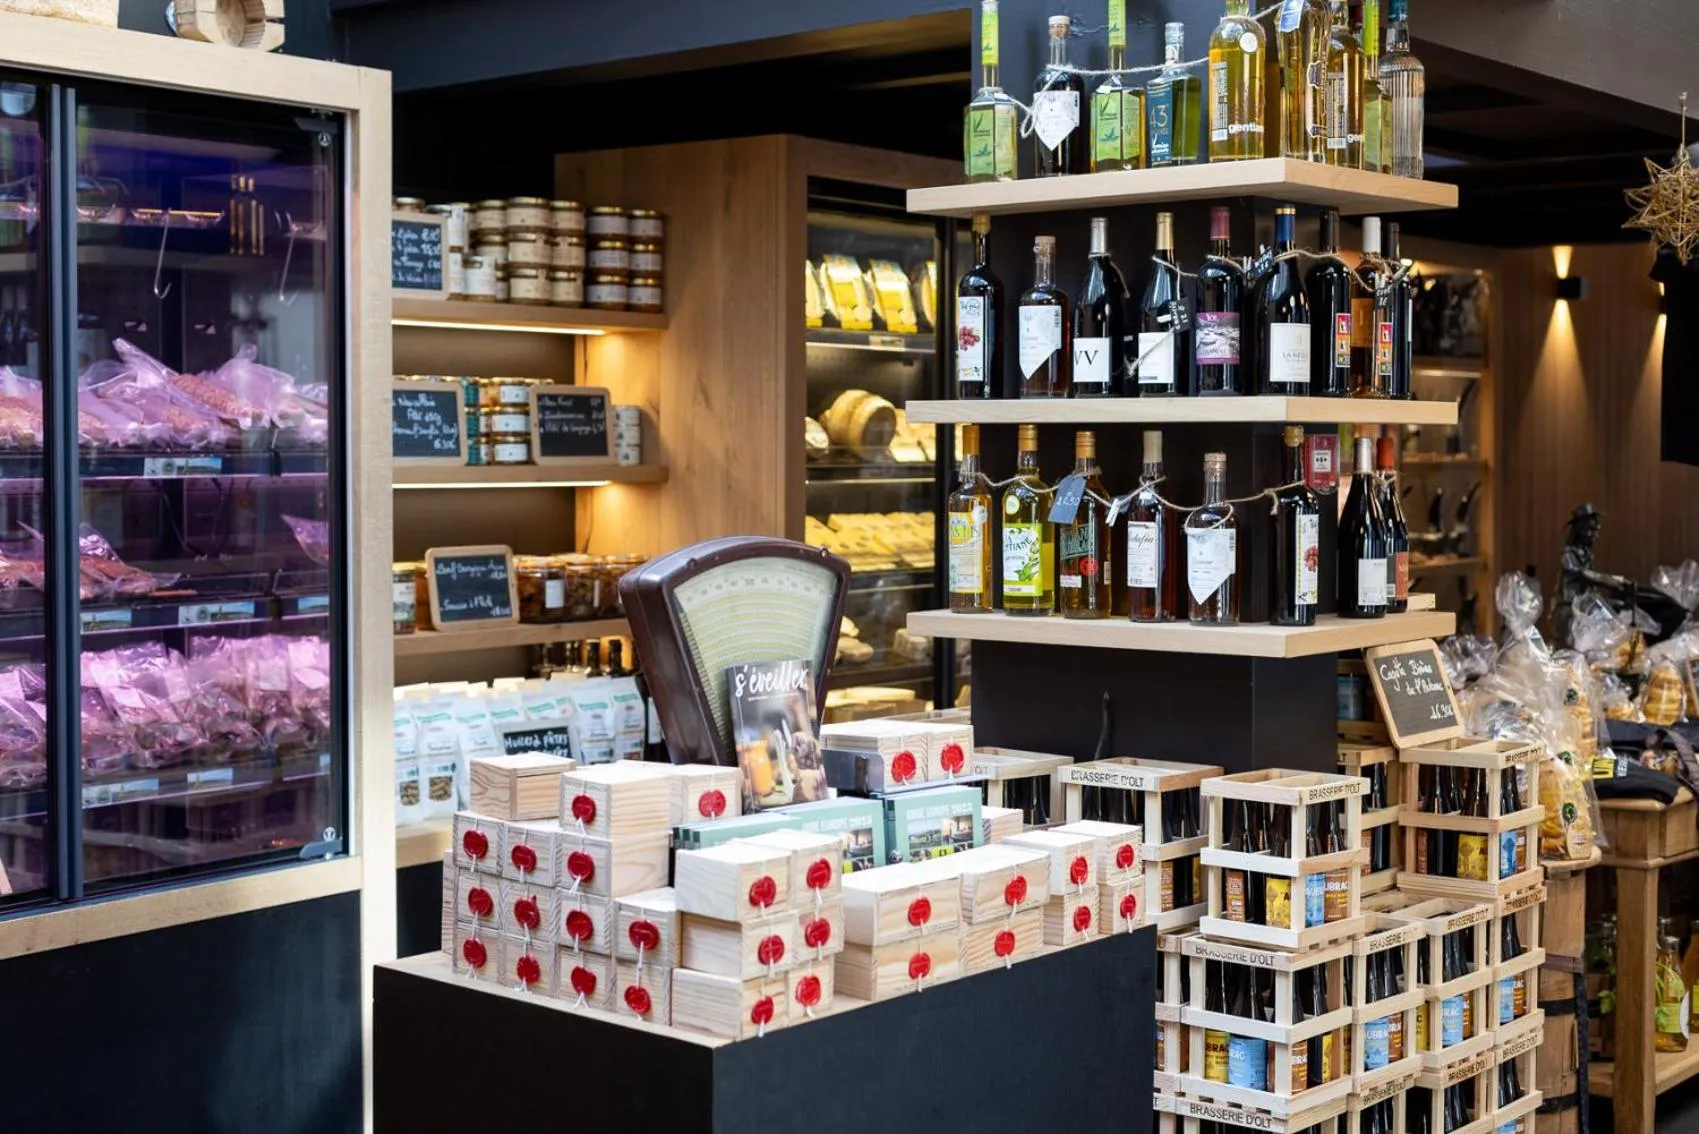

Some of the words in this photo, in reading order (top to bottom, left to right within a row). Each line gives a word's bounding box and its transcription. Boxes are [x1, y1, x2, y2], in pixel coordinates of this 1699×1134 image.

[1071, 769, 1118, 784] BRASSERIE
[1189, 1102, 1244, 1123] BRASSERIE
[1245, 1114, 1272, 1129] D'OLT
